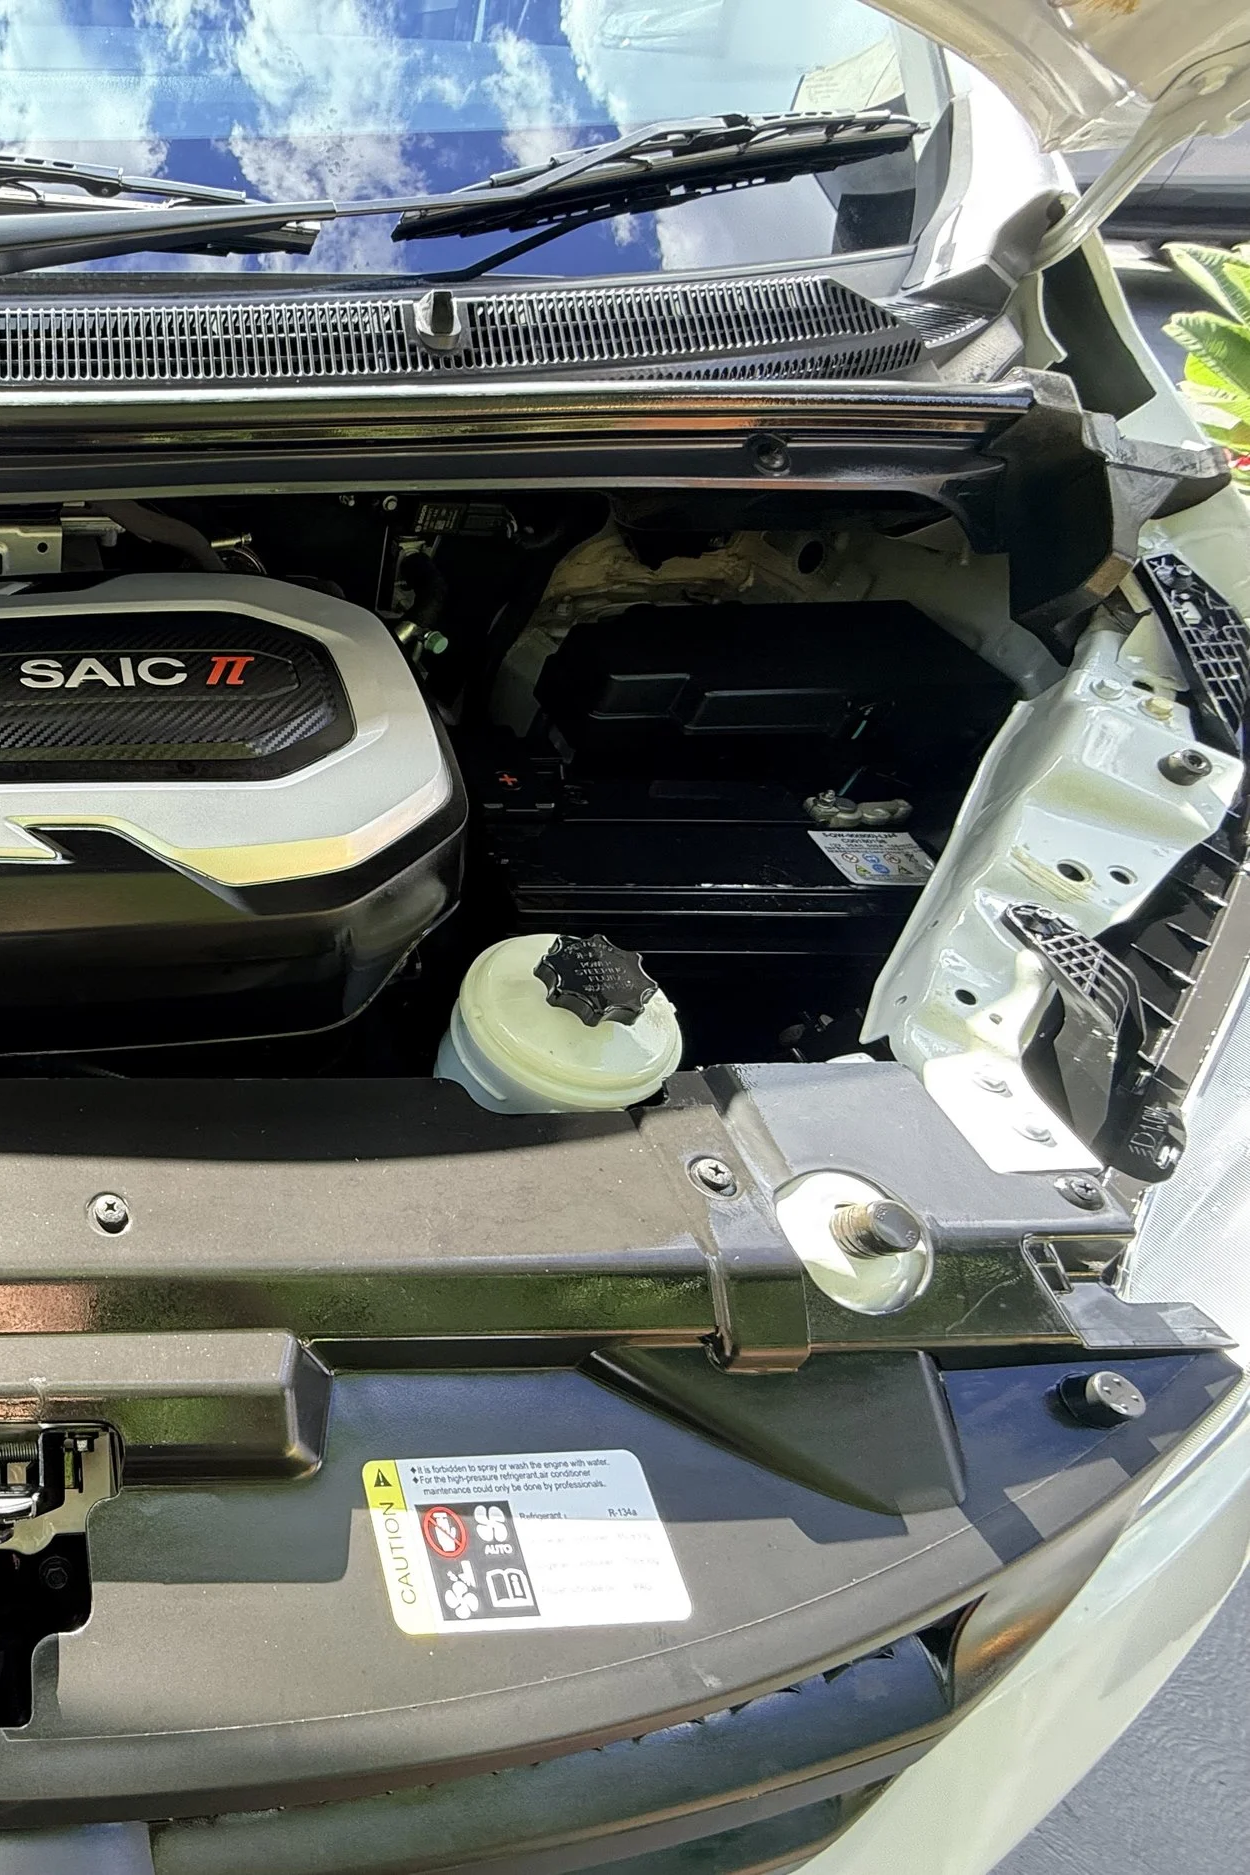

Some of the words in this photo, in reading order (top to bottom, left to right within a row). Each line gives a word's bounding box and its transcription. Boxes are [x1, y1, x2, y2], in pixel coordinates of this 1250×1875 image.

[20, 657, 188, 688] SAIC
[432, 1464, 467, 1473] forbidden
[467, 1464, 476, 1472] to
[477, 1464, 498, 1472] spray
[509, 1462, 529, 1470] wash
[530, 1461, 542, 1469] the
[543, 1460, 568, 1469] engine
[570, 1459, 586, 1467] with
[419, 1475, 433, 1484] For
[434, 1475, 446, 1483] the
[447, 1473, 498, 1484] high-pressure
[550, 1469, 591, 1478] conditioner
[423, 1486, 471, 1495] maintenance
[472, 1484, 494, 1493] could
[494, 1484, 510, 1494] only
[511, 1483, 521, 1491] be
[523, 1482, 542, 1491] done
[543, 1482, 553, 1492] by
[607, 1507, 638, 1518] R-134a
[379, 1502, 417, 1604] CAUTION
[484, 1543, 513, 1556] AUTO
